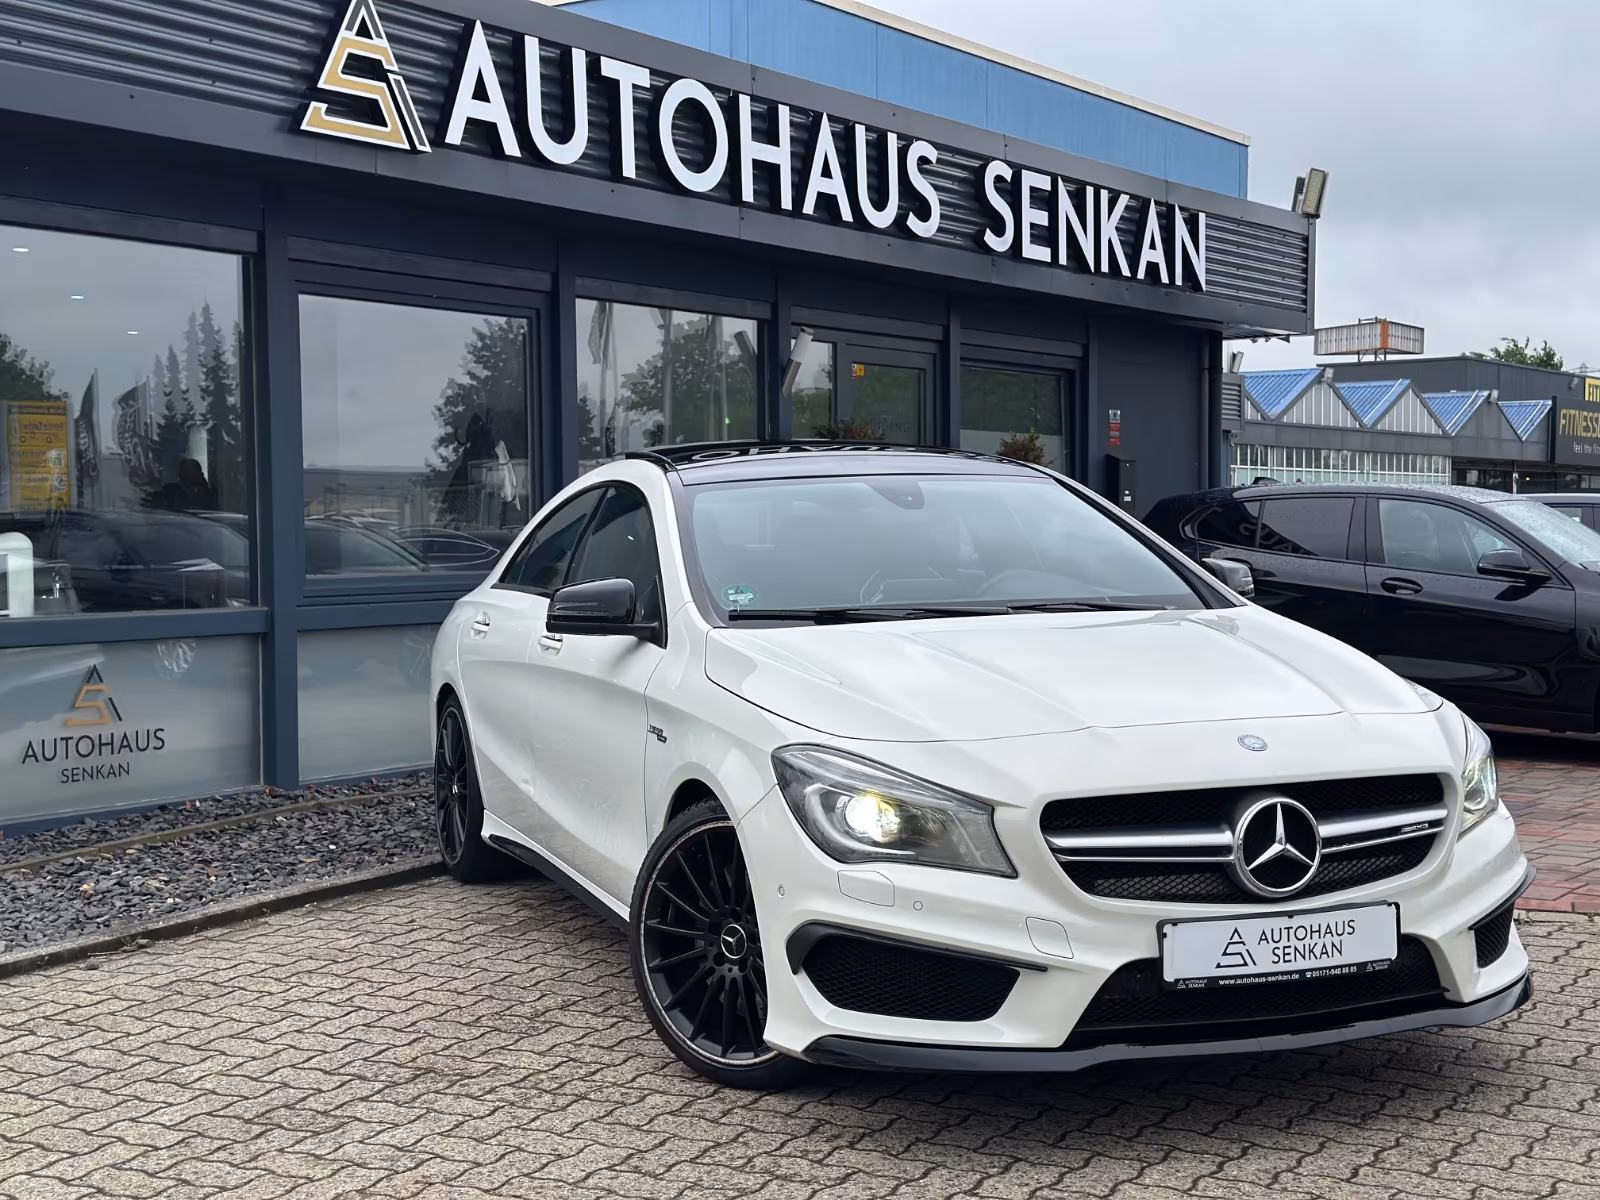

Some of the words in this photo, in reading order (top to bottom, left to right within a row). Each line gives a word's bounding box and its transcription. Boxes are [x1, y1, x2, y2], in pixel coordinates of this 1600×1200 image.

[445, 19, 941, 238] AUTOHAUS
[984, 160, 1206, 292] SENKAN
[21, 728, 165, 764] AUTOHAUS
[61, 762, 130, 784] SENKAN
[1257, 919, 1356, 946] AUTOHAUS
[1271, 940, 1343, 965] SENKAN
[1218, 973, 1300, 985] www.autohaus-senkan.de
[1312, 967, 1341, 977] 05171-940
[1350, 965, 1357, 973] 85
